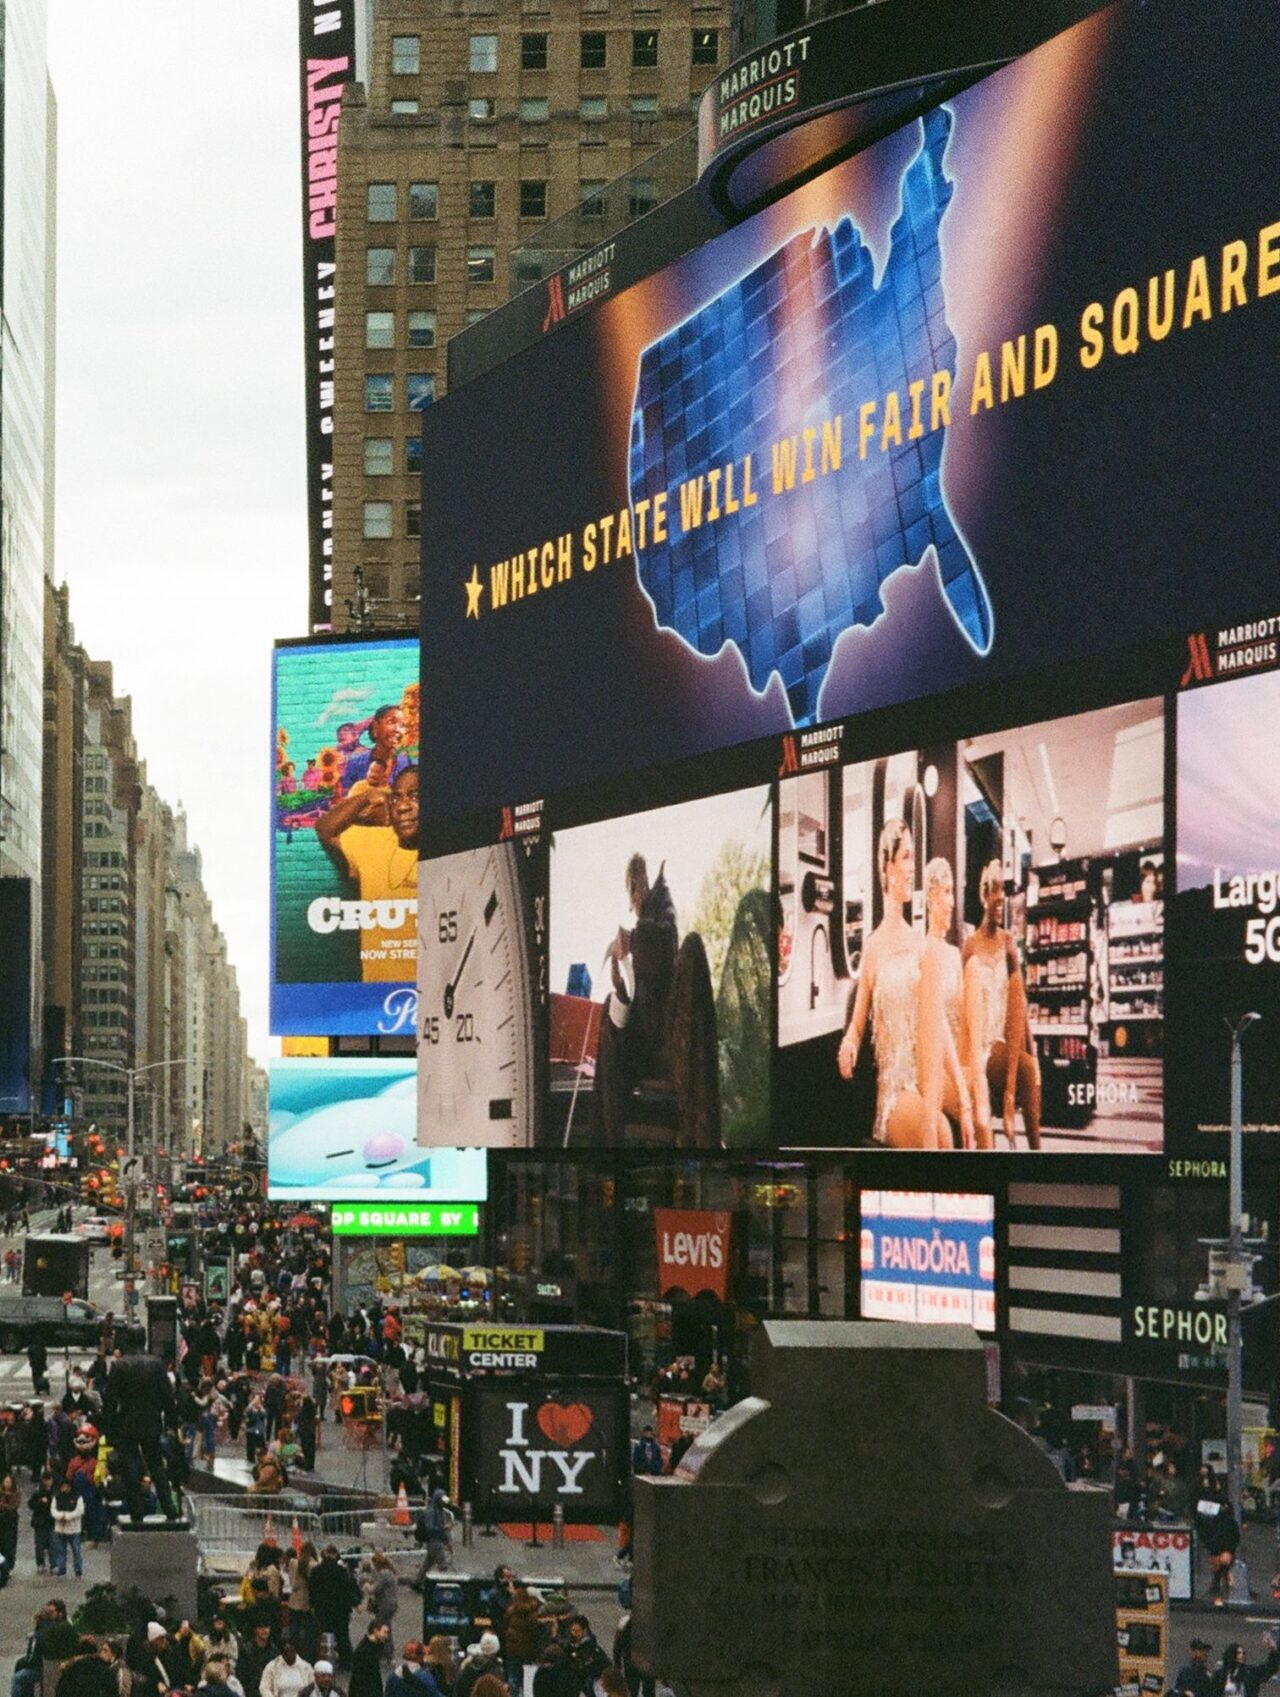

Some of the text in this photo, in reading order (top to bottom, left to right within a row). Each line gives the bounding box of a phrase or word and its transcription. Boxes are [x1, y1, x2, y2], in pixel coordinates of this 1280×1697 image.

[720, 36, 811, 104] MARRIOTT
[720, 78, 796, 138] MARQUIS
[568, 242, 616, 286] MARRIOTT
[567, 271, 610, 311] MARQUIS
[490, 221, 1280, 610] WHICH STATE WILL WIN FAIR AND SQUARE
[1218, 642, 1277, 671] MARQUIS
[801, 724, 845, 748] MARRIOTT
[801, 746, 839, 767] MARQUIS
[514, 799, 545, 817] MARRIOTT
[514, 816, 541, 833] MARQUIS
[1213, 868, 1280, 914] Larg
[438, 910, 458, 943] 65
[1245, 916, 1280, 964] 5G
[359, 950, 388, 961] NOW
[423, 1016, 440, 1045] 45
[455, 1013, 474, 1042] 20
[1067, 1083, 1139, 1106] SEPHORA
[1169, 1160, 1227, 1178] SEPHORA
[359, 1212, 432, 1227] SQUARE
[441, 1212, 462, 1226] BY
[149, 1239, 164, 1249] 25
[880, 1228, 971, 1276] PANDORA
[1134, 1305, 1243, 1344] SEPHOR
[470, 1333, 538, 1350] TICKET
[469, 1352, 538, 1368] CENTER
[506, 1402, 530, 1446] I
[498, 1450, 596, 1494] NY
